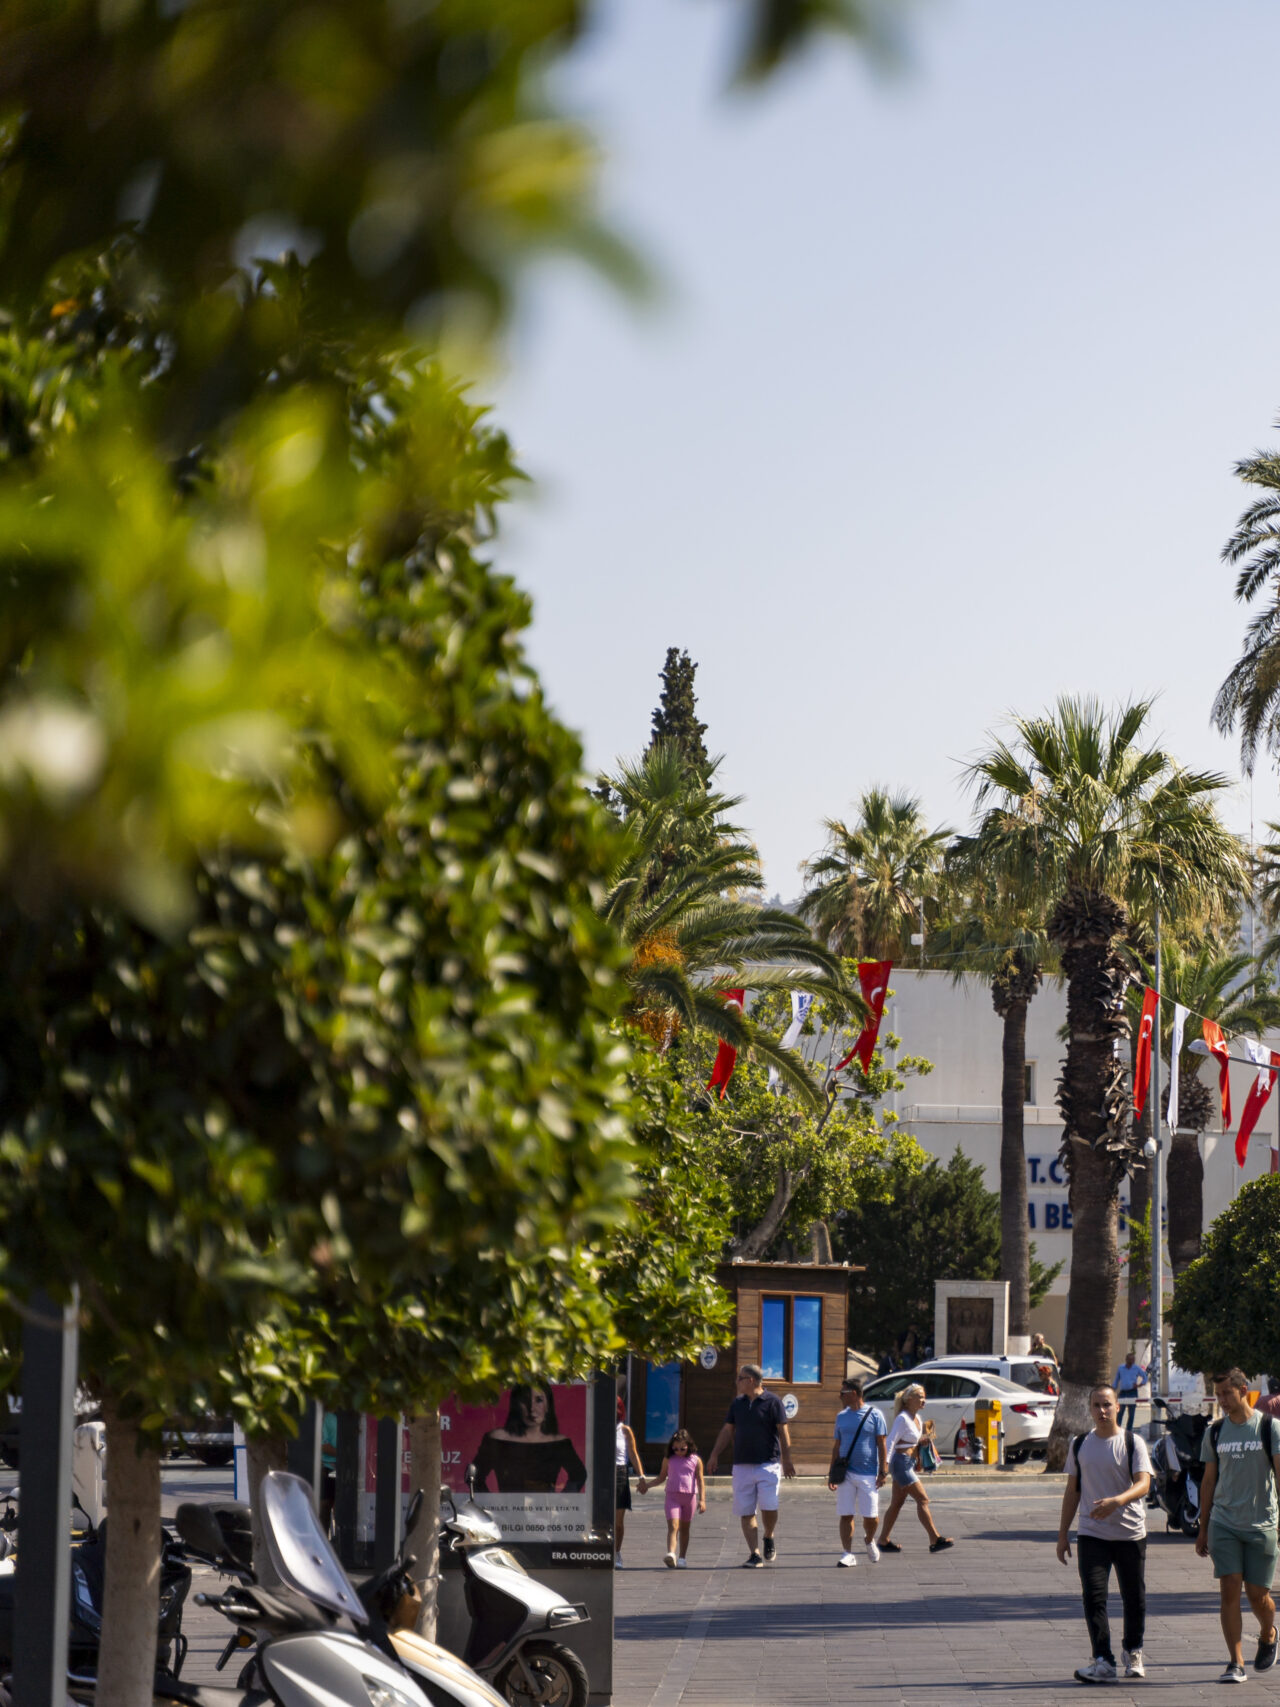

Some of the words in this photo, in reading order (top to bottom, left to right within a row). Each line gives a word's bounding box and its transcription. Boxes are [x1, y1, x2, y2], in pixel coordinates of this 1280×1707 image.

[1244, 1440, 1263, 1451] FOX
[564, 1524, 574, 1532] 10
[575, 1524, 586, 1532] 20
[552, 1551, 568, 1560] ERA
[569, 1552, 612, 1561] OUTDOOR
